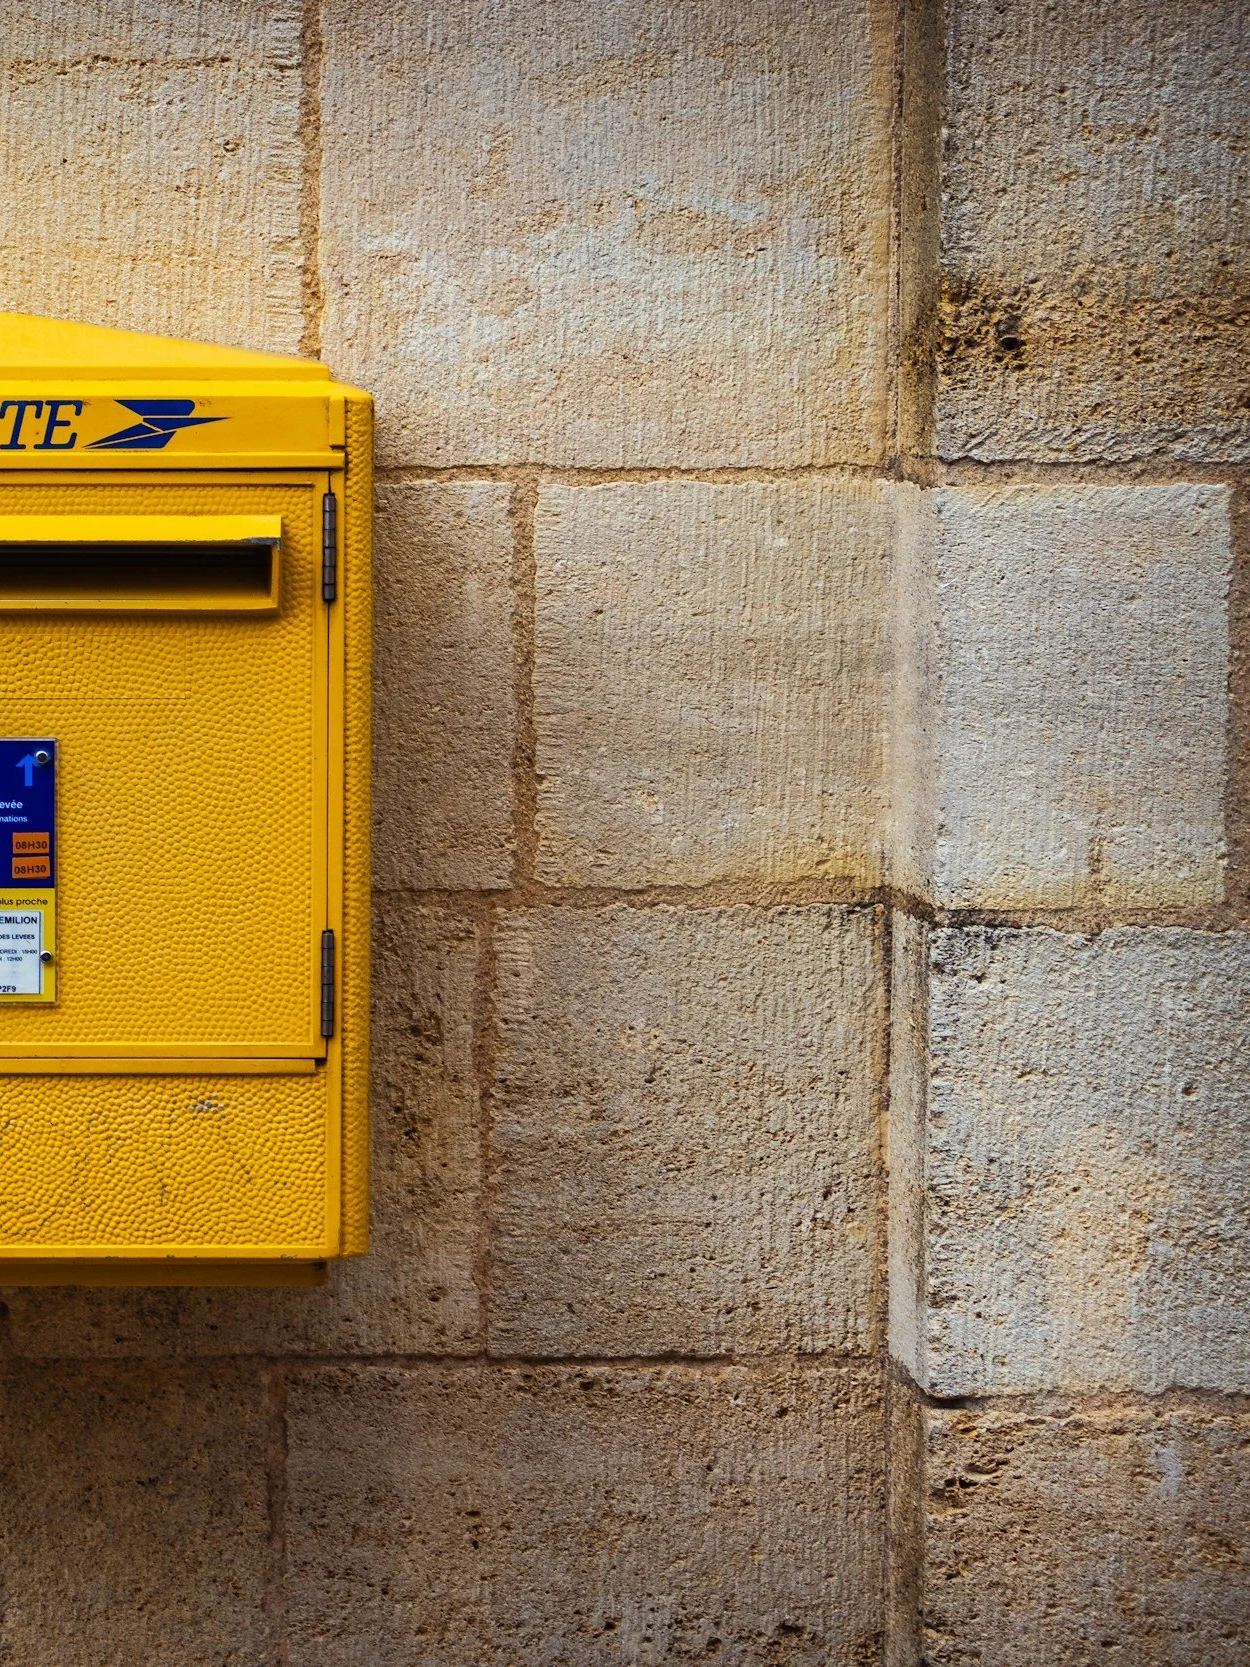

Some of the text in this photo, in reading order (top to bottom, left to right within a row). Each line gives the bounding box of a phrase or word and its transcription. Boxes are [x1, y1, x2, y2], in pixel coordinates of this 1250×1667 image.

[15, 840, 48, 850] 08H30
[14, 864, 47, 875] 08H30
[15, 897, 49, 907] proche
